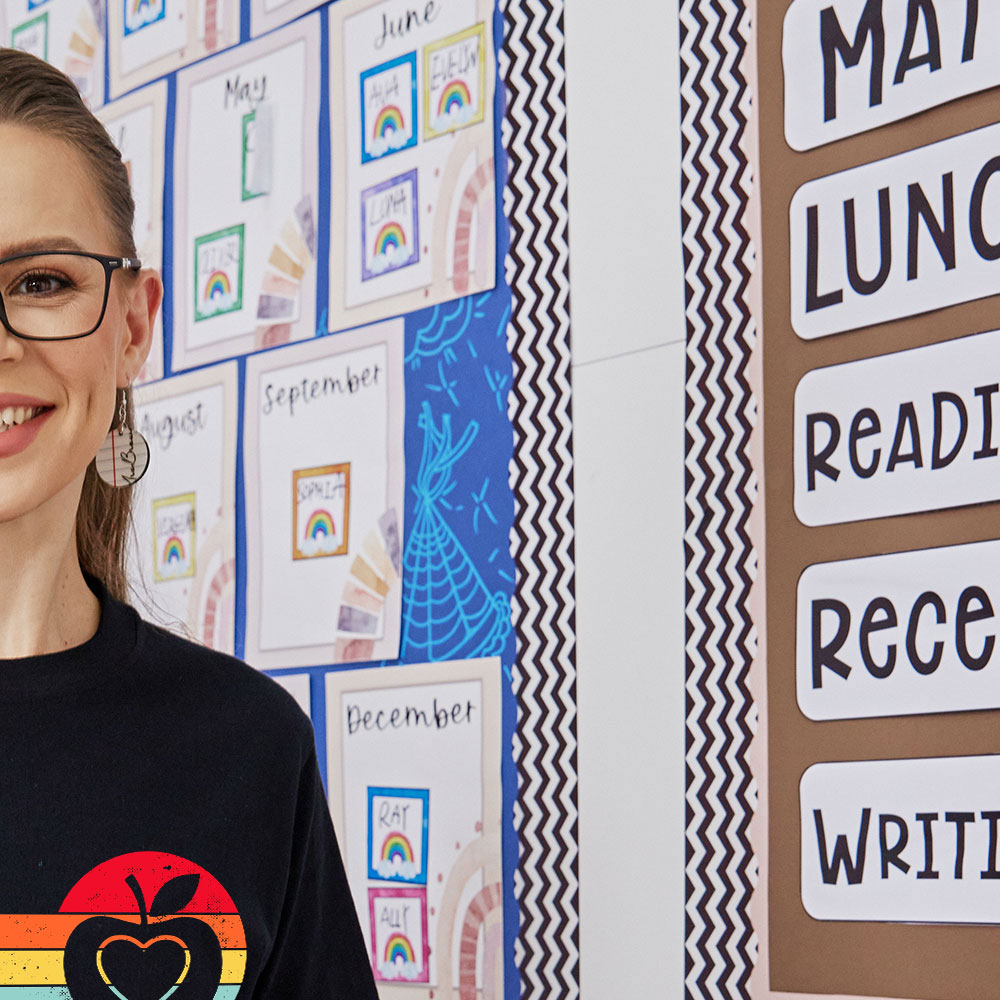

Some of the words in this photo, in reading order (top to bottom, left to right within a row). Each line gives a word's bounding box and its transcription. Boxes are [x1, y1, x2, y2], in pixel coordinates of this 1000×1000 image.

[374, 0, 435, 50] June
[223, 75, 267, 112] May
[263, 364, 382, 415] September
[140, 402, 206, 451] August
[347, 699, 477, 735] December
[378, 800, 411, 832] RAY
[813, 808, 1000, 885] WRITI
[380, 905, 411, 934] ALLY
